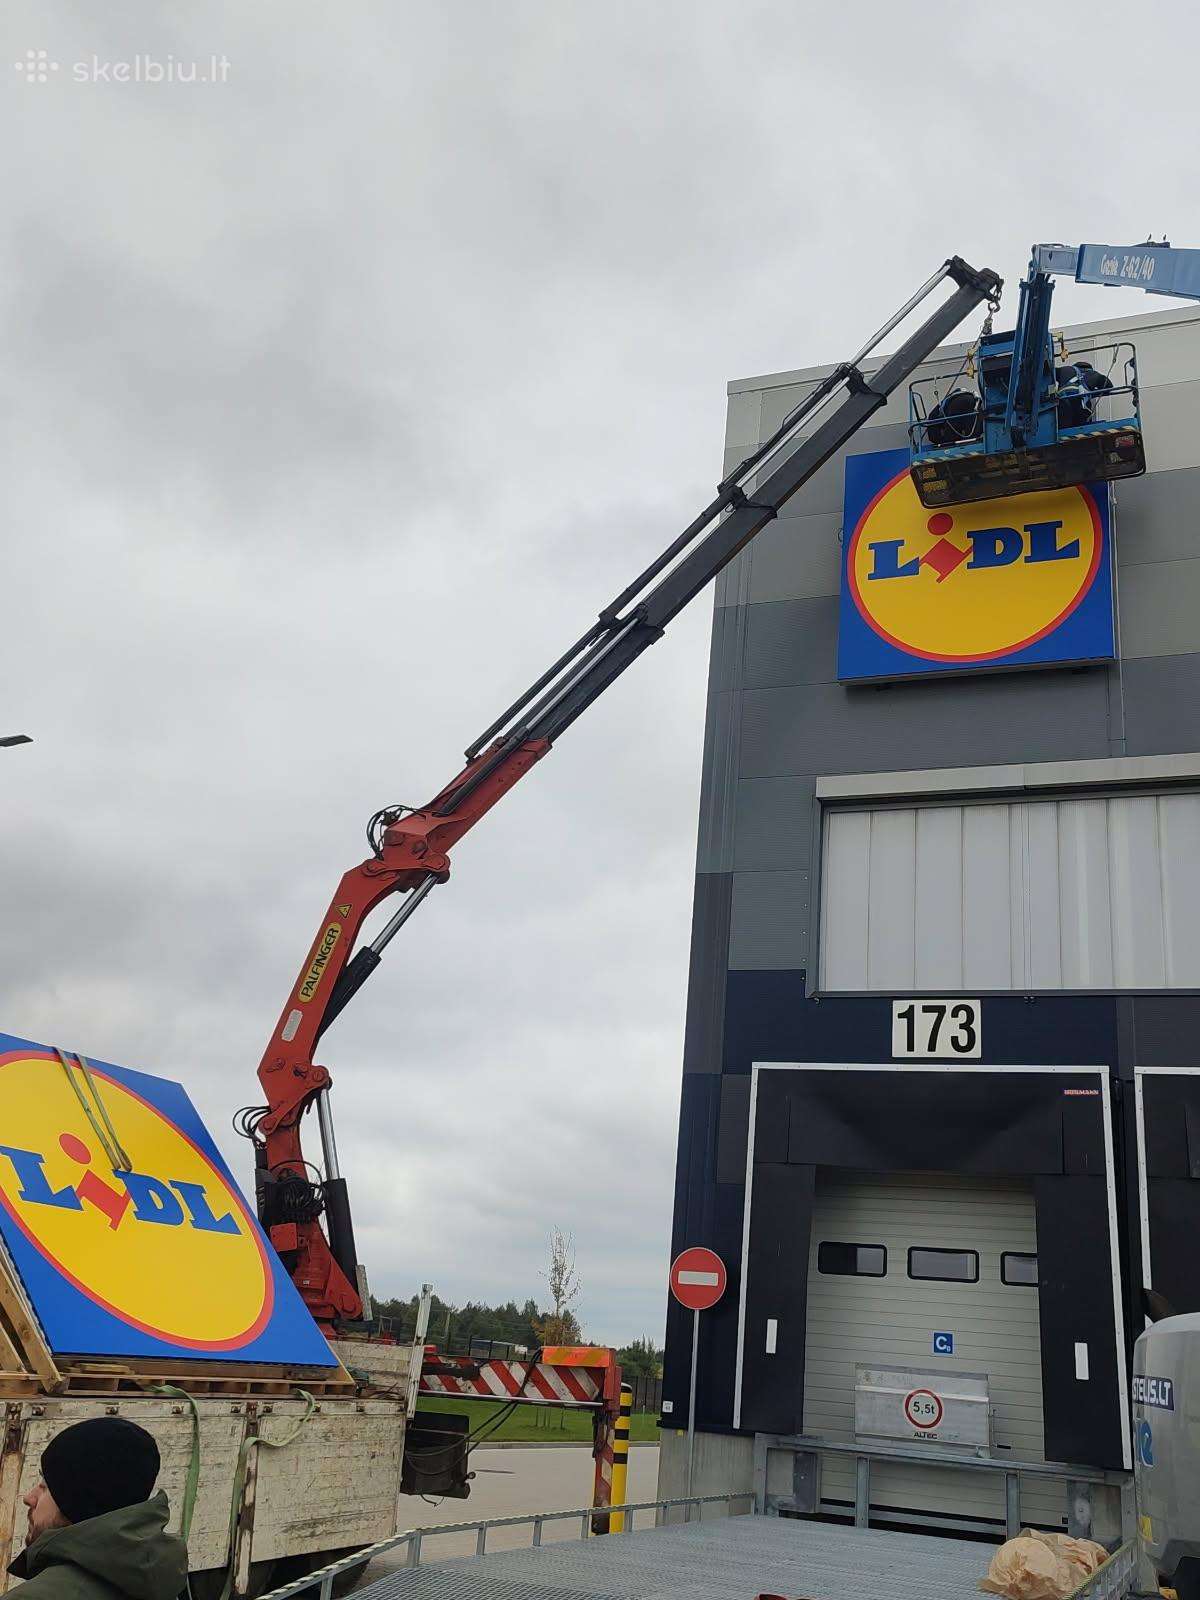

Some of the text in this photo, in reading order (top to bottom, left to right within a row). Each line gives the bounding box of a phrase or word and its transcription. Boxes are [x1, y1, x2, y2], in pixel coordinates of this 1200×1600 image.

[300, 926, 339, 998] PALFINGER
[897, 1003, 976, 1053] 173
[913, 1400, 935, 1415] 5,5t
[913, 1431, 938, 1440] ALTEC
